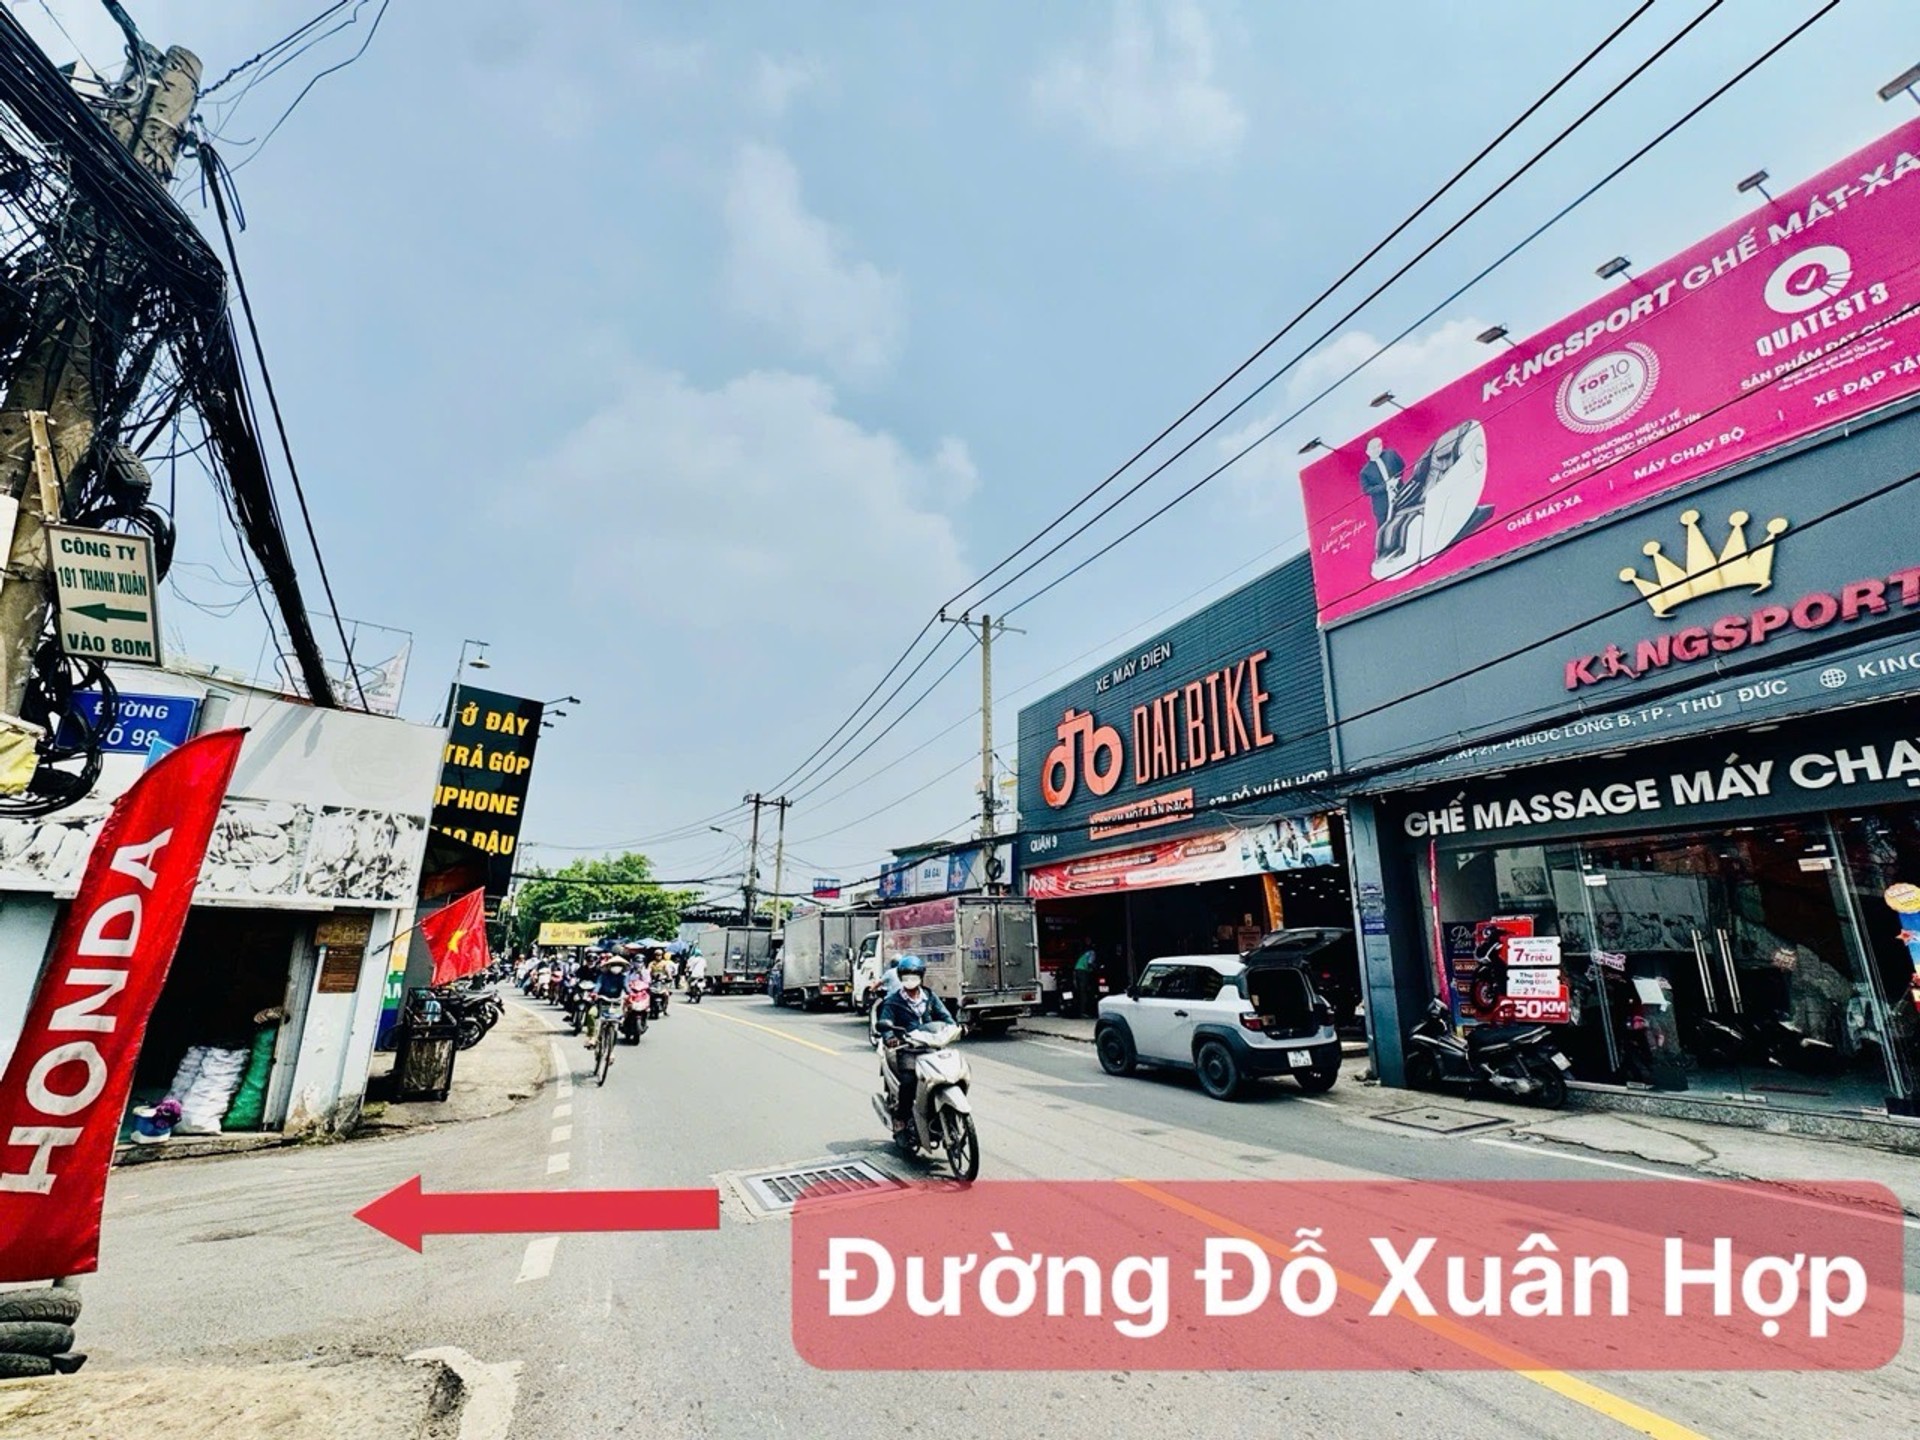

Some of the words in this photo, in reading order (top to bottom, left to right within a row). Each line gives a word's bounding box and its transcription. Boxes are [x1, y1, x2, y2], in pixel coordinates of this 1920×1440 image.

[1682, 227, 1760, 290] GHẾ
[1578, 373, 1610, 394] TOP
[1813, 389, 1839, 407] XE
[1843, 371, 1887, 392] ĐẠP
[1633, 458, 1667, 480] MÁY
[61, 537, 111, 558] CÔNG
[116, 545, 136, 560] TY
[59, 567, 77, 588] 191
[80, 568, 116, 593] THANH
[67, 631, 106, 652] VÀO
[111, 638, 152, 657] 80M
[1096, 674, 1110, 694] XE
[1113, 659, 1137, 685] MÁY
[1141, 642, 1170, 670] ĐIỆN
[461, 702, 480, 728] Ở
[485, 712, 529, 736] ĐÂY
[1132, 650, 1275, 785] DAT.BIKE
[1563, 717, 1614, 738] LONG
[1677, 689, 1722, 714] THỦ
[1738, 679, 1789, 702] ĐỨC
[488, 751, 531, 775] GÓP
[1404, 791, 1466, 837] GHẾ
[1473, 778, 1661, 831] MASSAGE
[1671, 752, 1774, 806] MÁY
[1051, 835, 1058, 848] 9
[1514, 948, 1525, 962] 7
[1, 827, 173, 1195] HONDA
